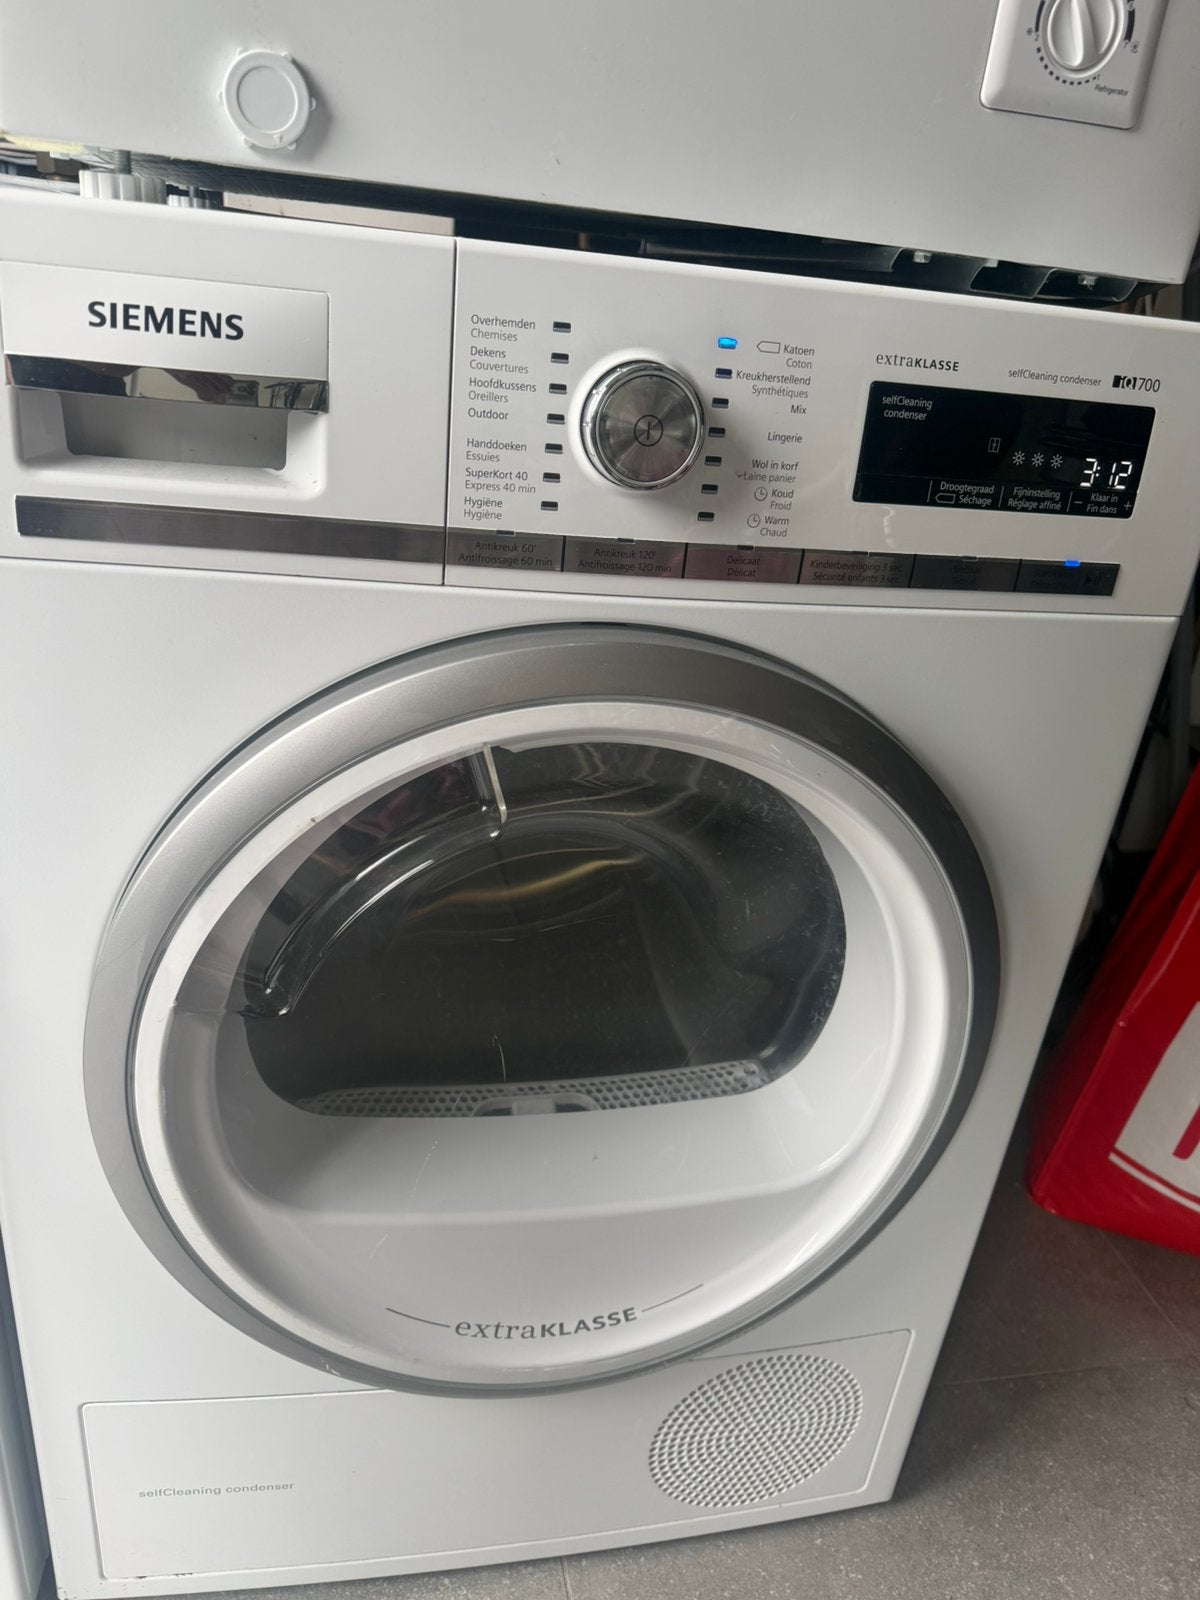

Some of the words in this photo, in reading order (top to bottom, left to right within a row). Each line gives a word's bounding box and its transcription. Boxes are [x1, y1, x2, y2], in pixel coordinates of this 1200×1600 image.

[88, 301, 244, 341] SIEMENS
[471, 314, 536, 330] Overhemden
[470, 327, 518, 342] Chemises
[470, 345, 506, 358] Dekens
[783, 344, 815, 356] Katoen
[469, 359, 529, 374] Couvertures
[785, 358, 813, 369] Coton
[876, 353, 960, 372] extraKLASSE
[736, 370, 811, 386] Kreukherstellend
[1008, 368, 1059, 385] selfCleaning
[1060, 374, 1102, 387] condenser
[469, 377, 537, 392] Hoofdkussens
[468, 390, 509, 403] Oreillers
[752, 384, 809, 399] Synthétiques
[790, 404, 807, 415] Mix
[882, 395, 933, 411] selfCleaning
[467, 407, 509, 420] Outdoor
[883, 409, 928, 421] condenser
[767, 431, 803, 445] Lingerie
[466, 438, 527, 452] Handdoeken
[466, 450, 500, 462] Essuies
[752, 459, 769, 470] Wol
[770, 460, 779, 470] in
[781, 461, 799, 471] korf
[465, 467, 513, 480] SuperKort
[515, 471, 528, 481] 40
[743, 471, 768, 482] Laine
[769, 474, 797, 484] panier
[1080, 457, 1133, 490] 3:12
[465, 480, 501, 492] Express
[503, 483, 516, 493] 40
[518, 484, 536, 494] min
[940, 481, 995, 495] Droogtegraad
[1013, 486, 1061, 501] Fijninstelling
[771, 489, 794, 499] Koud
[958, 494, 993, 506] Séchage
[1090, 492, 1110, 503] Klaar
[1111, 495, 1119, 503] in
[464, 496, 503, 509] Hygiëne
[769, 501, 792, 511] Froid
[1007, 498, 1037, 511] Réglage
[1038, 500, 1062, 511] affiné
[1086, 503, 1099, 513] Fin
[1099, 504, 1118, 514] dans
[463, 509, 503, 521] Hygiène
[764, 516, 790, 526] Warm
[760, 527, 788, 538] Chaud
[474, 541, 519, 553] Antikreuk
[459, 553, 519, 566] Antifroissage
[521, 557, 533, 566] 60
[535, 557, 553, 567] min
[593, 548, 637, 560] Antikreuk
[578, 560, 635, 572] Antifroissage
[637, 563, 653, 571] 120
[655, 563, 672, 573] min
[727, 567, 756, 577] Délicat
[881, 563, 889, 572] 3
[812, 571, 846, 582] Sécurité
[848, 574, 879, 583] enfants
[454, 1306, 638, 1340] extraKLASSE
[138, 1487, 222, 1498] selfCleaning
[225, 1482, 295, 1493] condenser
